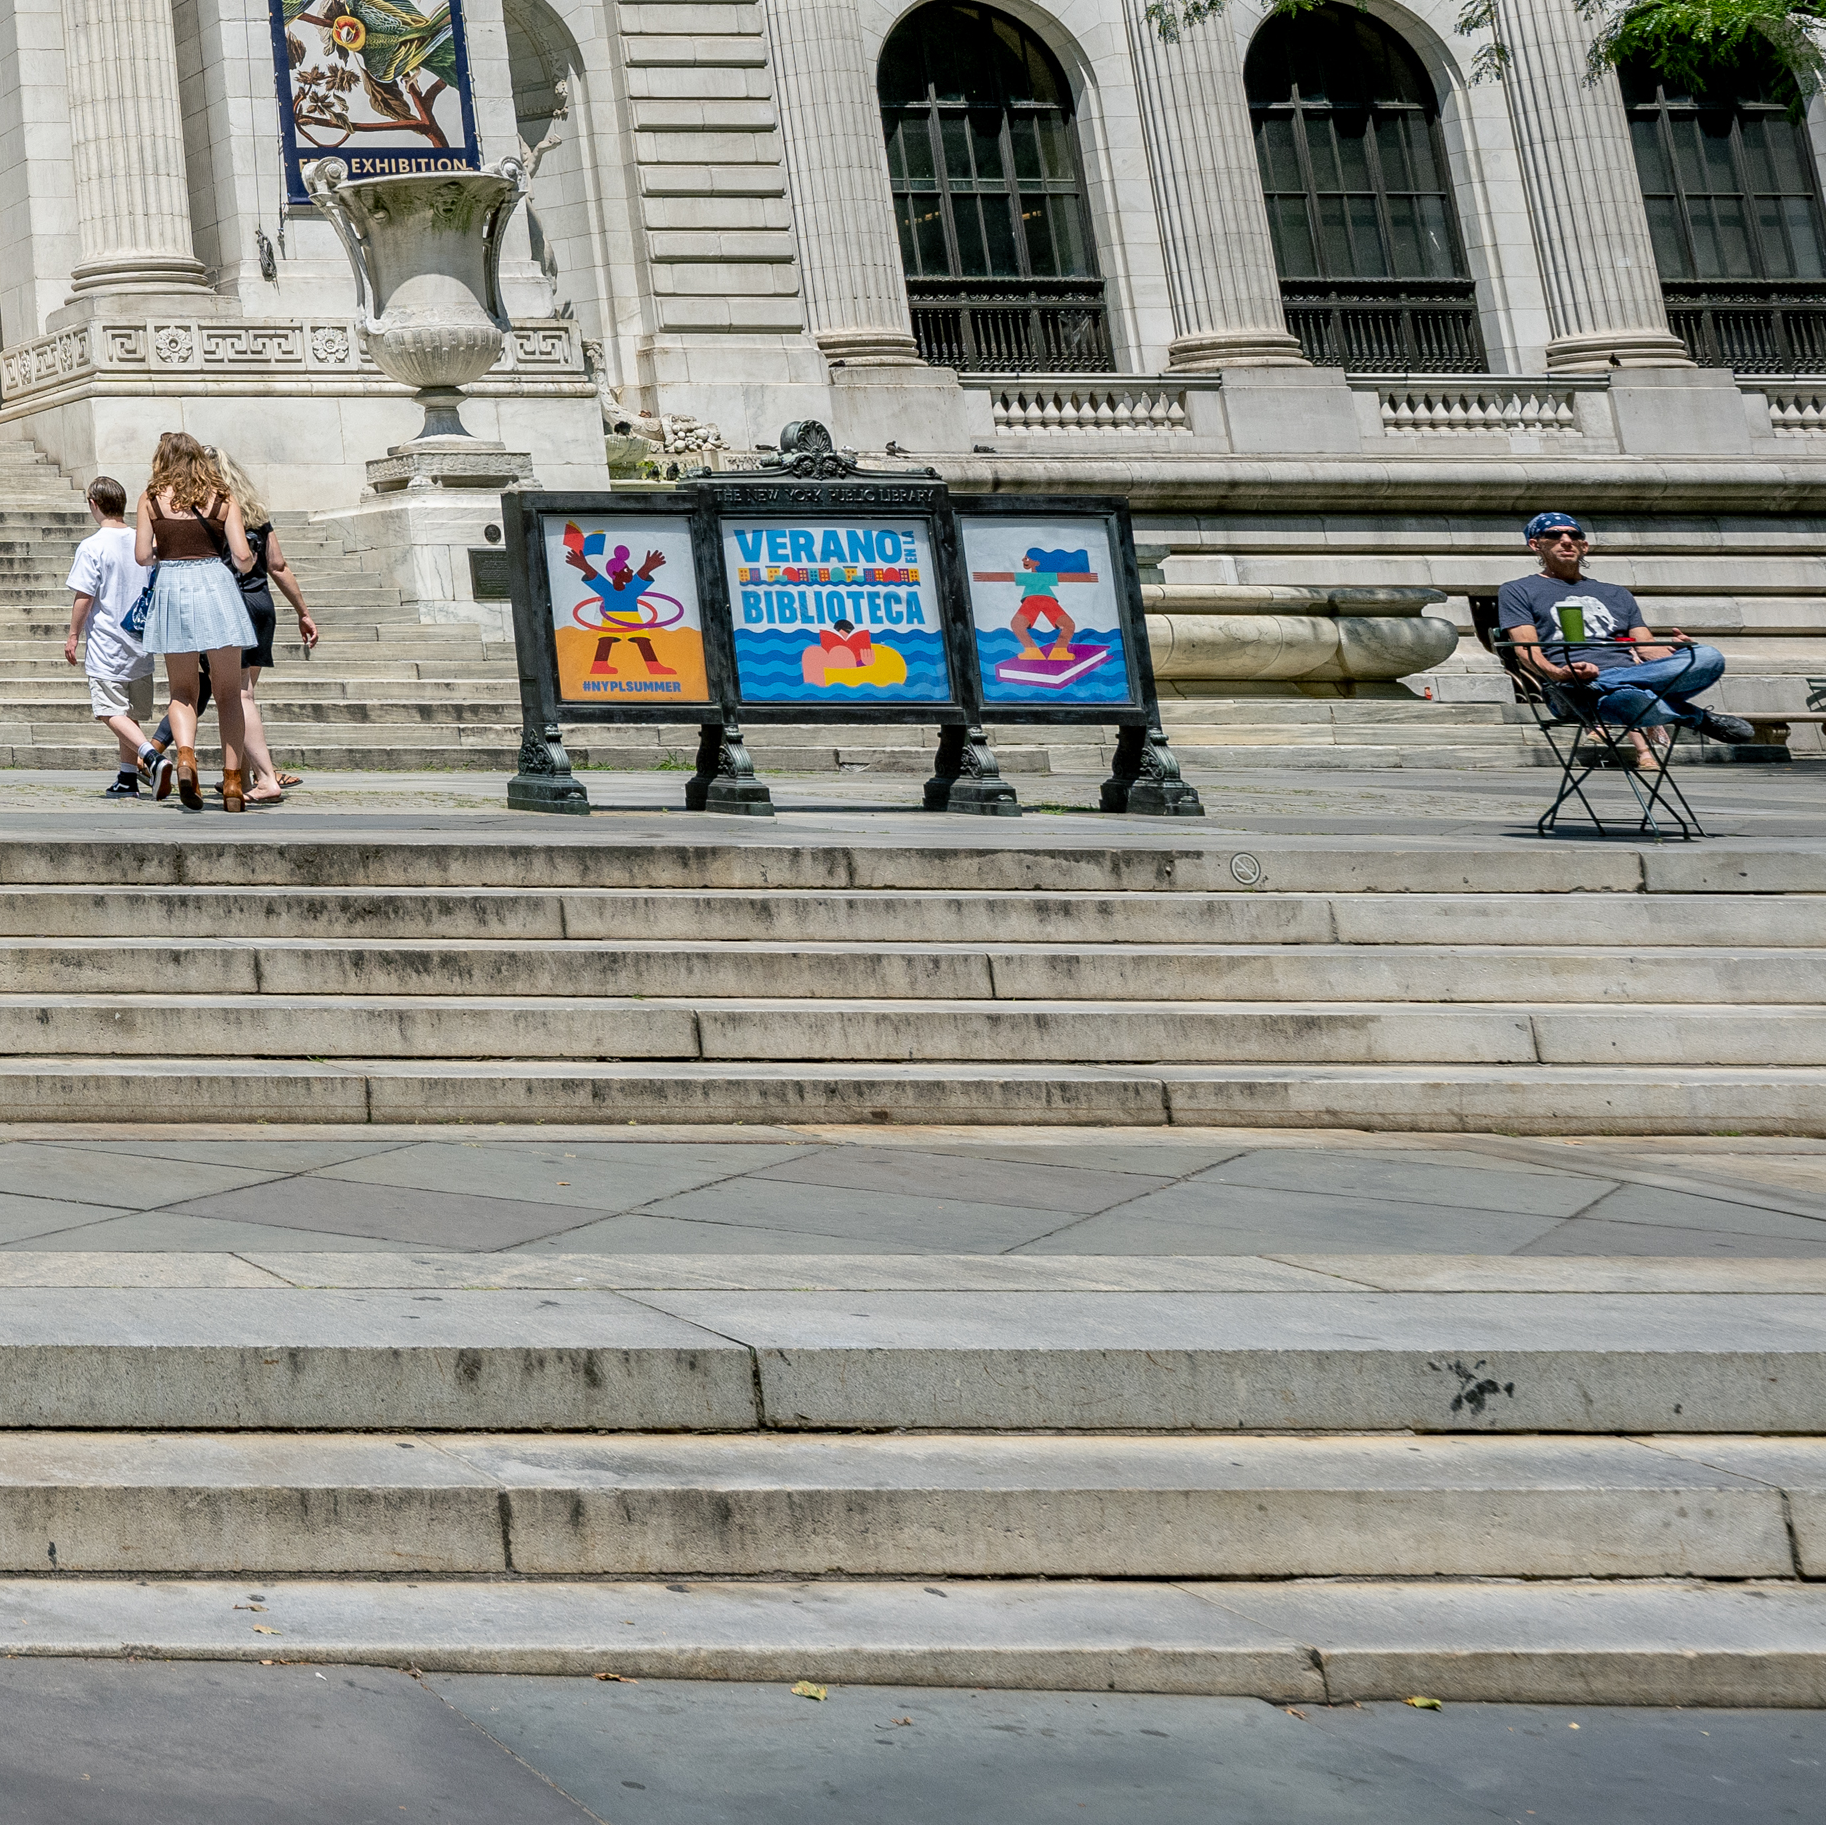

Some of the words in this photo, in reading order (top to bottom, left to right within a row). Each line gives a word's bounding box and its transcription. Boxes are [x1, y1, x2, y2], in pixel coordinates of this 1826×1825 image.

[351, 158, 468, 173] EXHIBITION
[713, 488, 742, 502] THE
[747, 488, 780, 502] NEW
[785, 488, 823, 502] YORK
[828, 488, 876, 502] PUBLIC
[880, 488, 934, 502] LIBRARY
[901, 530, 915, 544] LA
[733, 529, 902, 563] VERANO
[904, 548, 918, 563] EN
[741, 590, 925, 624] BIBLIOTECA
[582, 681, 681, 692] #NYPLSUMMER
